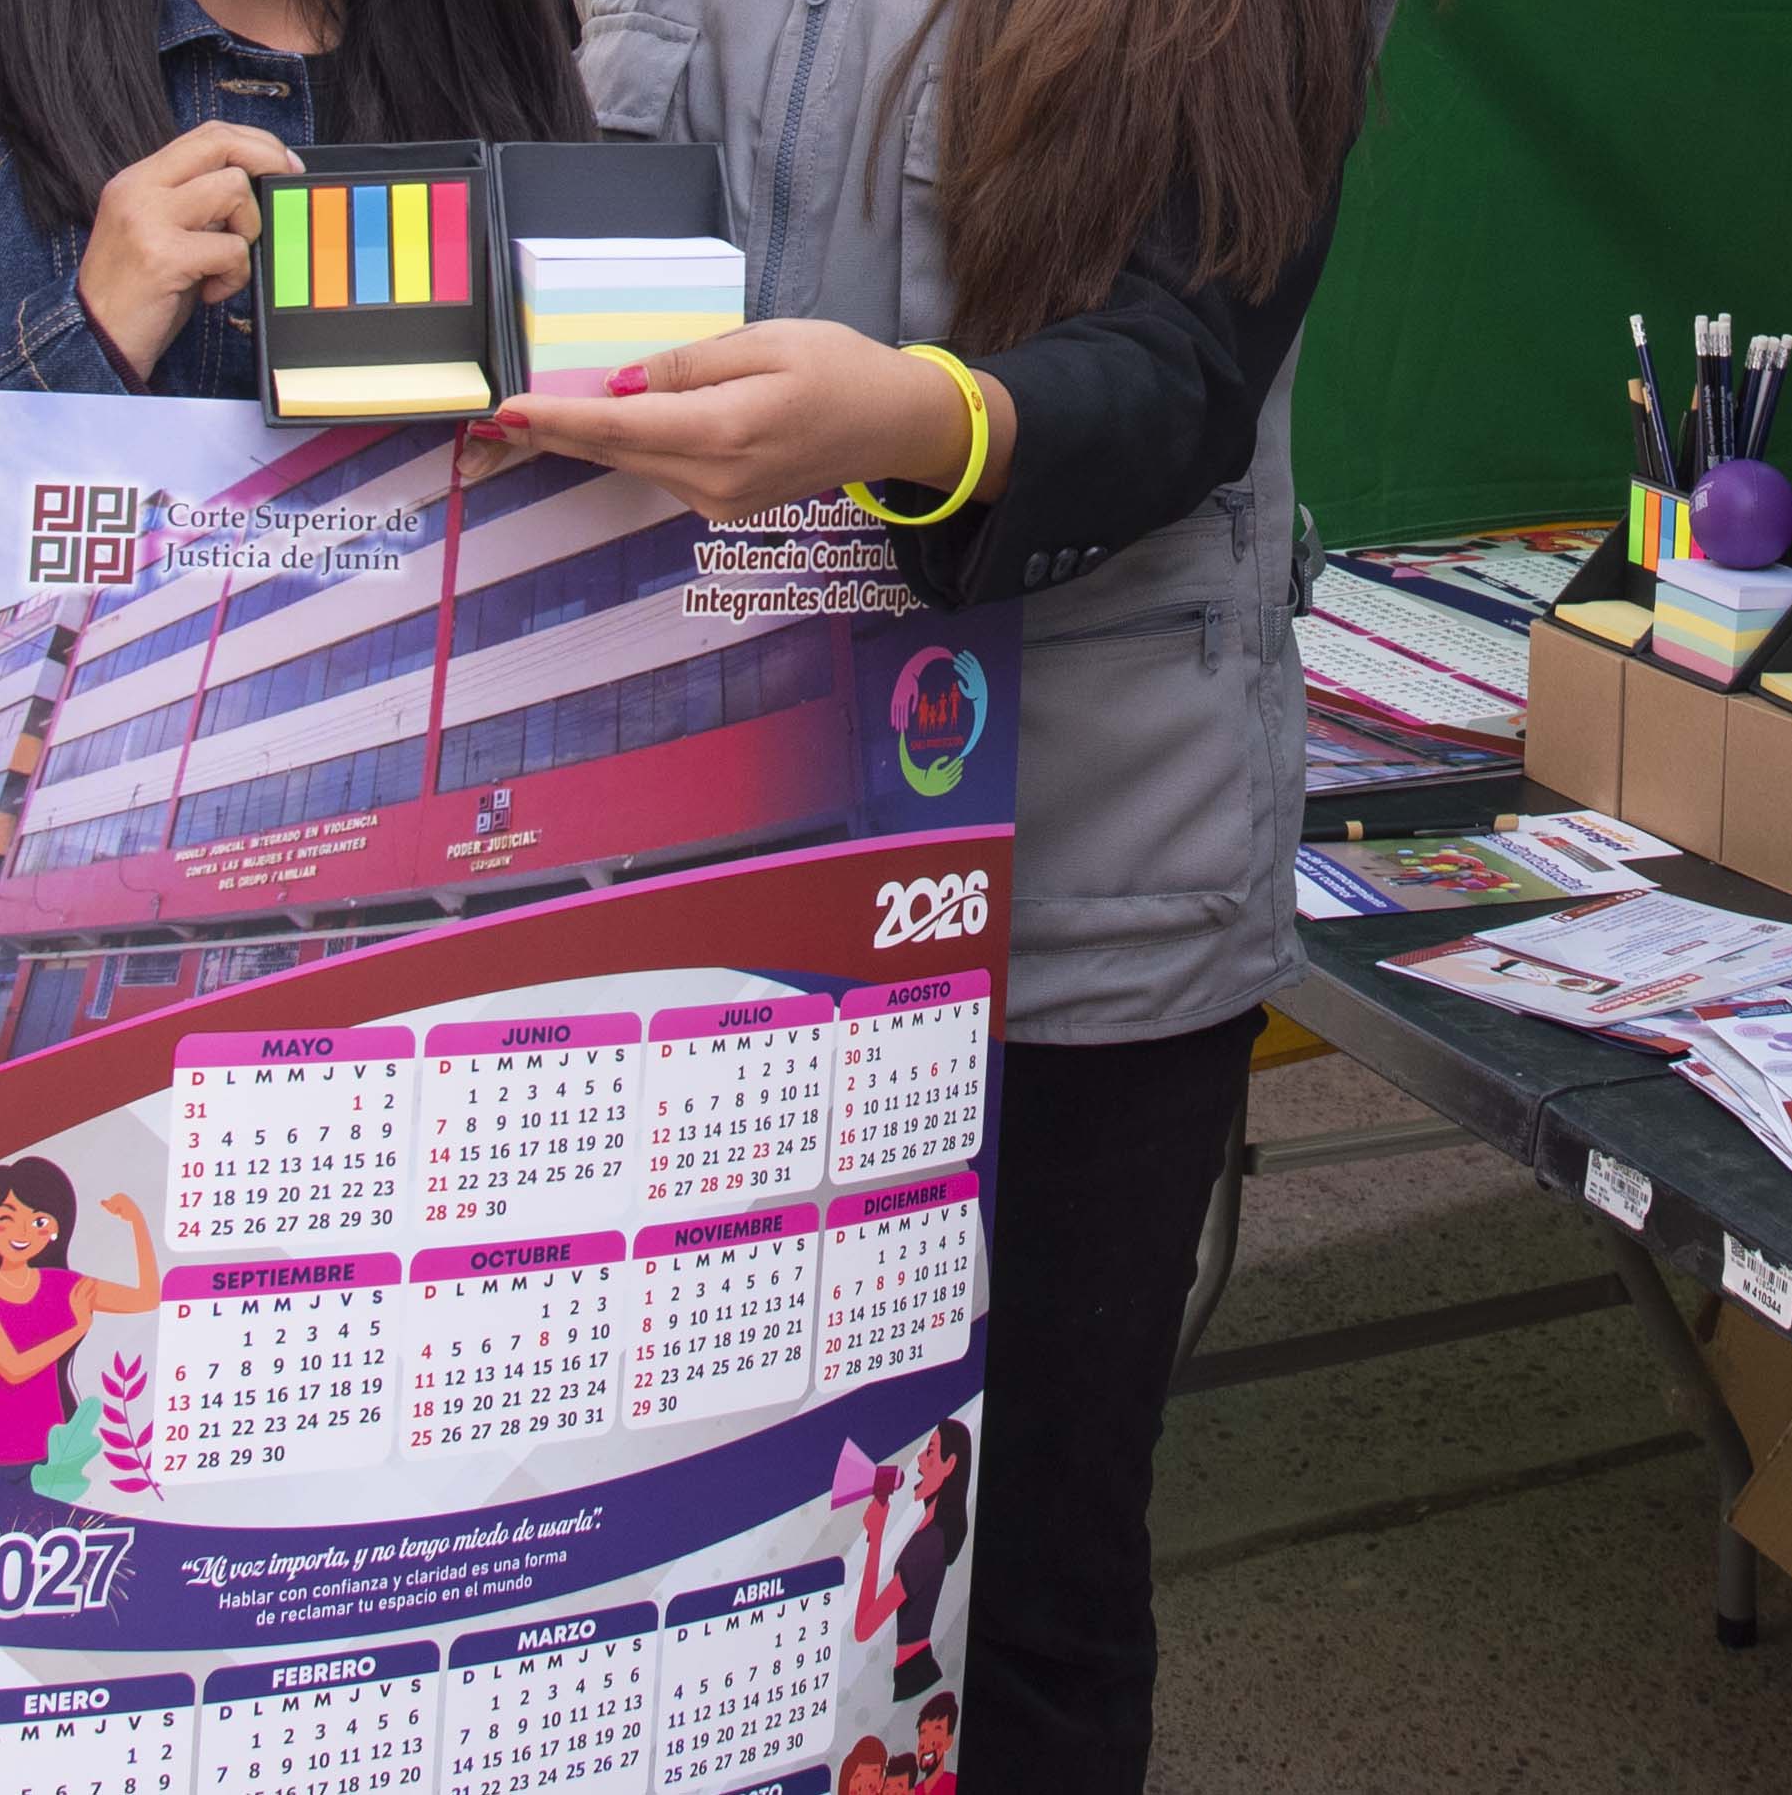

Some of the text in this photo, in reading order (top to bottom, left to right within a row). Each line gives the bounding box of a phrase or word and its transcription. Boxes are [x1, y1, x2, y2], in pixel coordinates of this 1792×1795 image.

[167, 502, 419, 538] Corte Superior de
[163, 542, 401, 576] Justicia de Junín
[696, 540, 882, 572] Violencia Contra
[685, 583, 856, 621] Integrantes del
[304, 824, 319, 839] EN
[322, 813, 379, 837] VIOLENCIA
[1548, 816, 1633, 852] Proteger
[445, 829, 539, 861] PODER JUDICIAL
[873, 868, 990, 950] 2026
[886, 980, 952, 1007] AGOSTO
[717, 1006, 774, 1029] JULIO
[261, 1036, 334, 1059] MAYO
[501, 1024, 571, 1047] JUNIO
[863, 1182, 948, 1217] DICIEMBRE
[673, 1214, 784, 1248] NOVIEMBRE
[469, 1242, 572, 1272] OCTUBRE
[210, 1262, 356, 1293] SEPTIEMBRE
[1742, 1278, 1783, 1316] M 410344
[230, 1561, 266, 1580] voz
[267, 1545, 350, 1583] importa,
[352, 1548, 368, 1571] y
[370, 1543, 397, 1565] no
[398, 1532, 451, 1564] tengo
[452, 1521, 510, 1555] miedo
[511, 1516, 536, 1544] de
[218, 1547, 568, 1610] Hablar con confianza y claridad es una forma
[731, 1577, 786, 1607] ABRIL
[255, 1573, 534, 1627] de reclamar tu espacio en el mundo
[516, 1619, 598, 1653] MARZO
[271, 1655, 377, 1689] FEBRERO
[23, 1687, 111, 1716] ENERO
